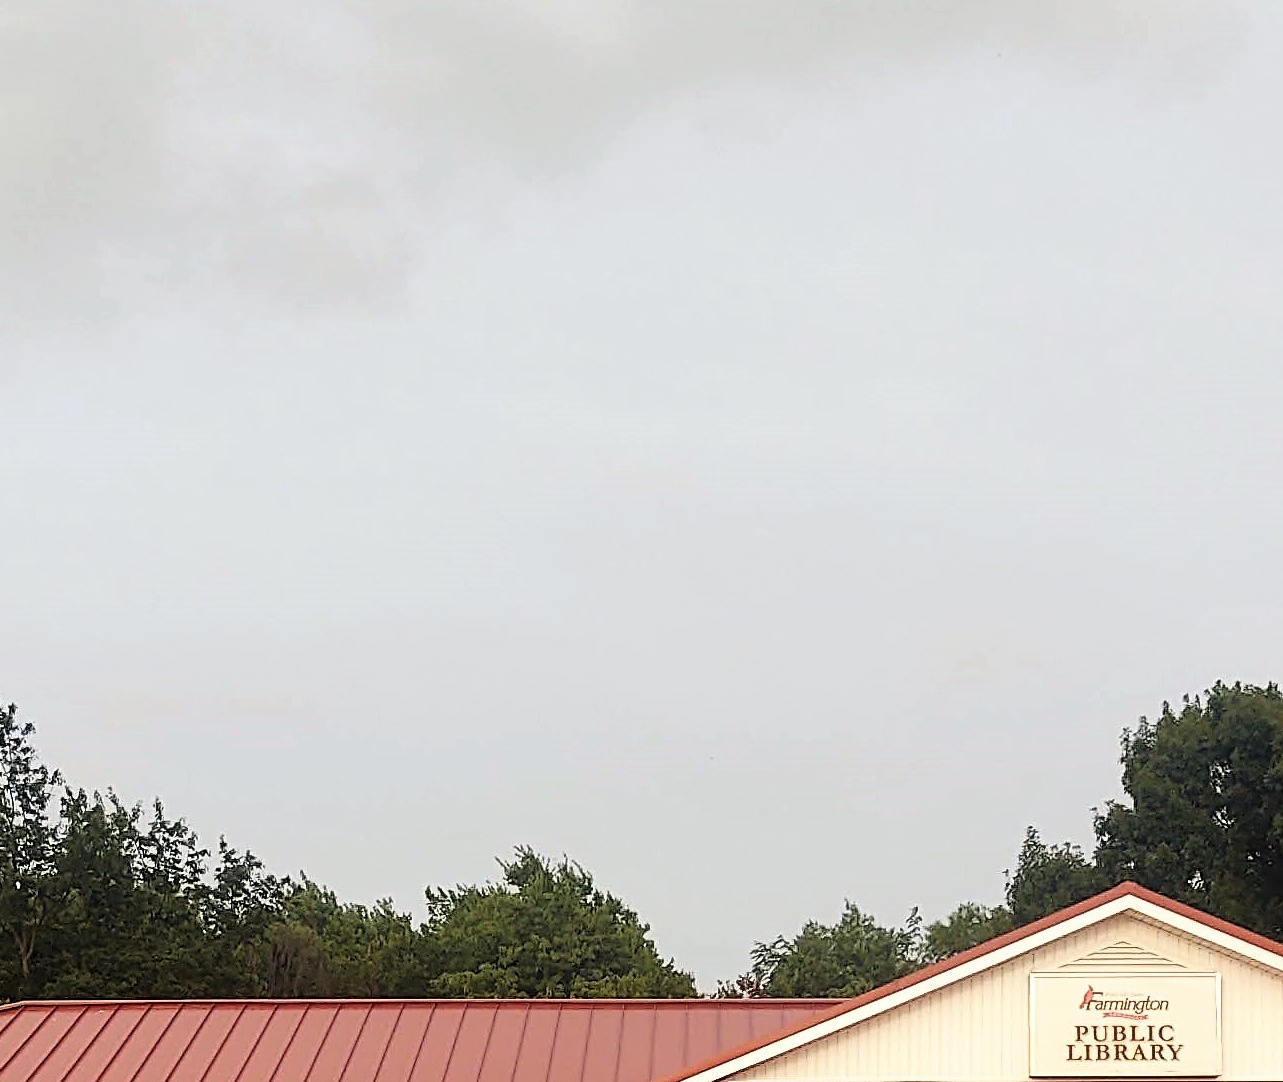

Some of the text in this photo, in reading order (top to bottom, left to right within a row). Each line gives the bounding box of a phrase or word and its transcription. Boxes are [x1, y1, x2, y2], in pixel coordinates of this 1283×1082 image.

[1084, 990, 1170, 1014] Farmington
[1074, 1024, 1174, 1042] PUBLIC
[1065, 1043, 1184, 1062] LIBRARY
